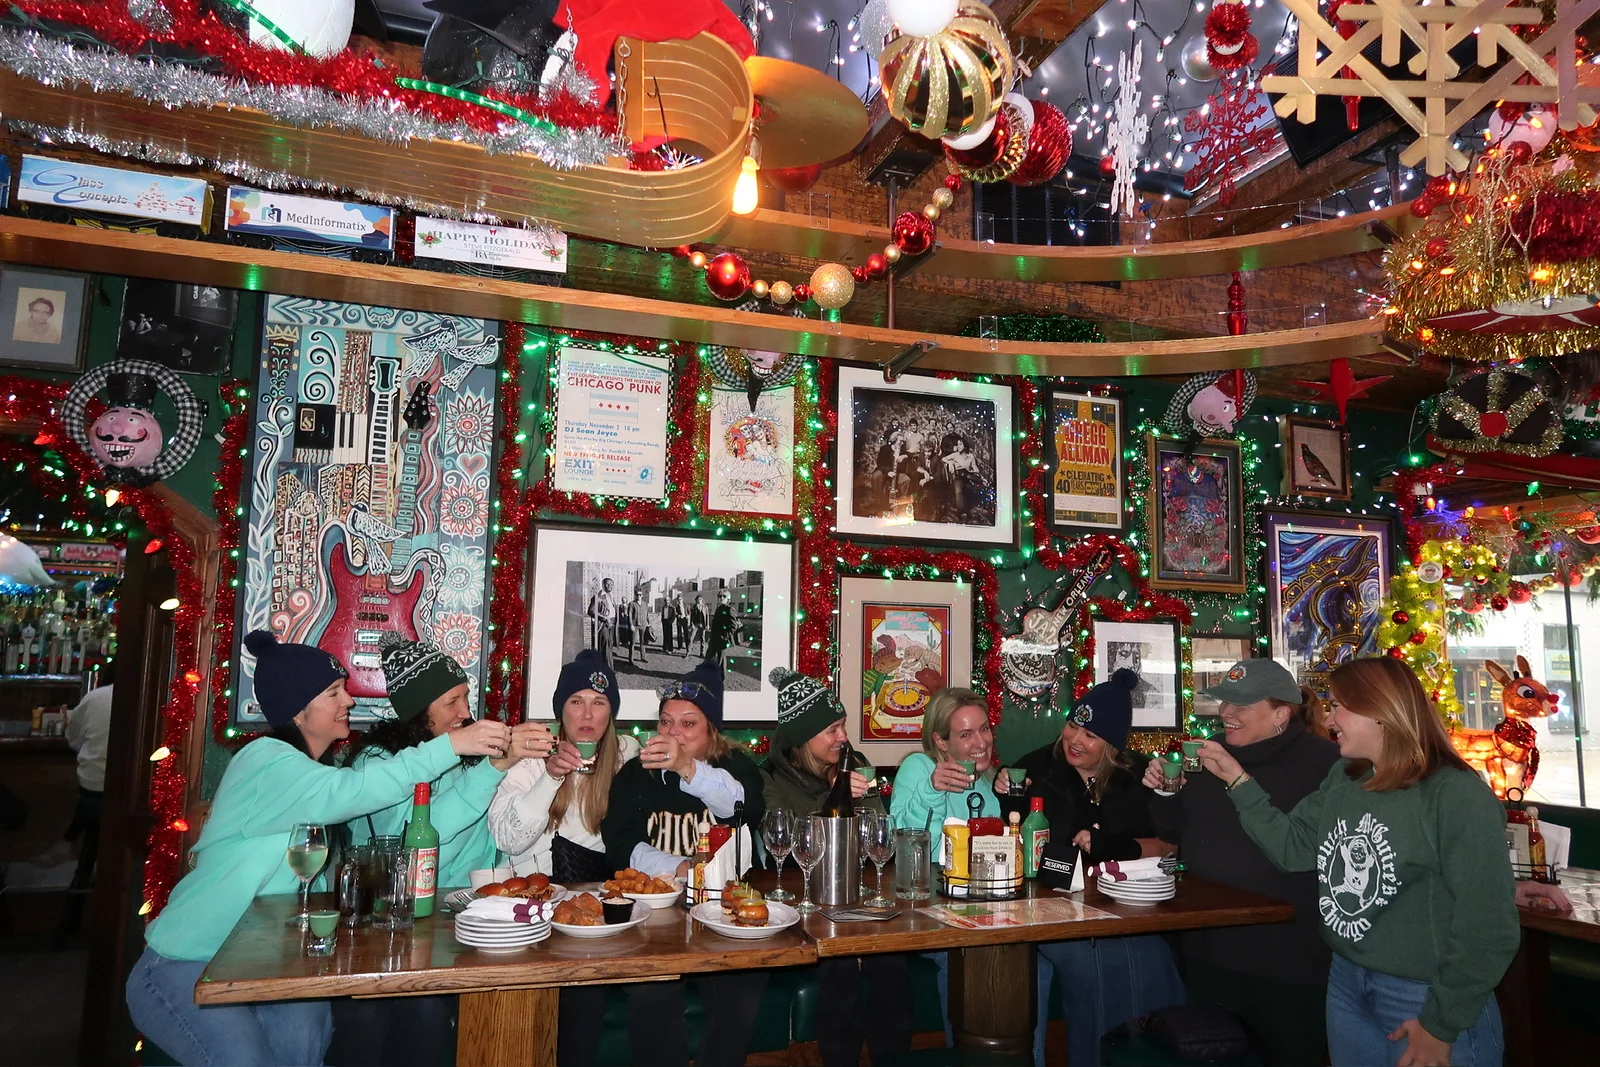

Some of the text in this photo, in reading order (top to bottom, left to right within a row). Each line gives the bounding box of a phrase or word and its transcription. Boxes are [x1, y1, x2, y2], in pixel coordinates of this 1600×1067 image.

[286, 212, 367, 231] MedInformatix
[432, 230, 556, 250] HAPPY HOLIDAYS
[484, 245, 521, 254] FITZGERALD
[567, 376, 661, 395] CHICAGO PUNK
[565, 420, 587, 428] Thursday
[589, 421, 614, 430] November
[1064, 419, 1107, 448] GREGG
[564, 458, 595, 469] EXIT
[1060, 443, 1111, 467] ALLMAN
[564, 468, 594, 476] LOUNGE
[1056, 479, 1071, 494] 40
[1053, 569, 1094, 629] NEW ORLEANS
[1317, 812, 1402, 896] Butch McGuire's
[1045, 860, 1070, 871] RESERVED
[1319, 896, 1372, 942] Chicago
